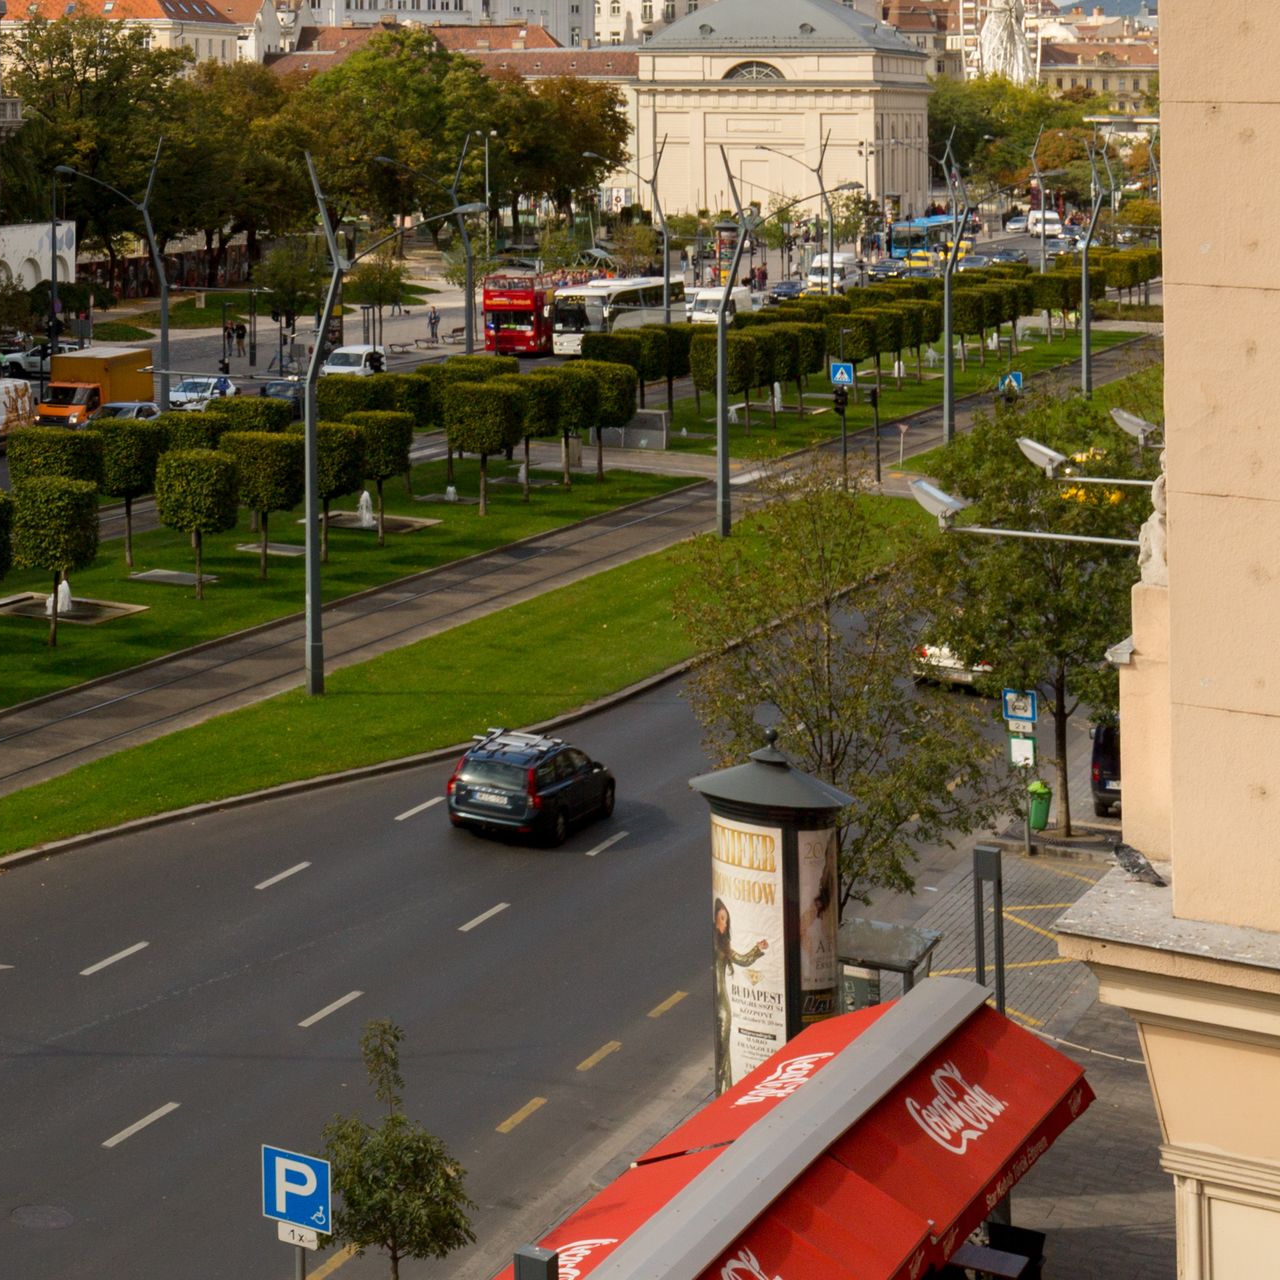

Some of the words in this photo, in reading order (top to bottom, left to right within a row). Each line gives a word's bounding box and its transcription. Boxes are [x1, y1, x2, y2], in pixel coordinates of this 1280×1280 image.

[733, 877, 777, 906] SHOW
[731, 984, 783, 1005] BUDAPEST
[905, 1059, 1009, 1155] Coca-Cola
[274, 1156, 317, 1214] P
